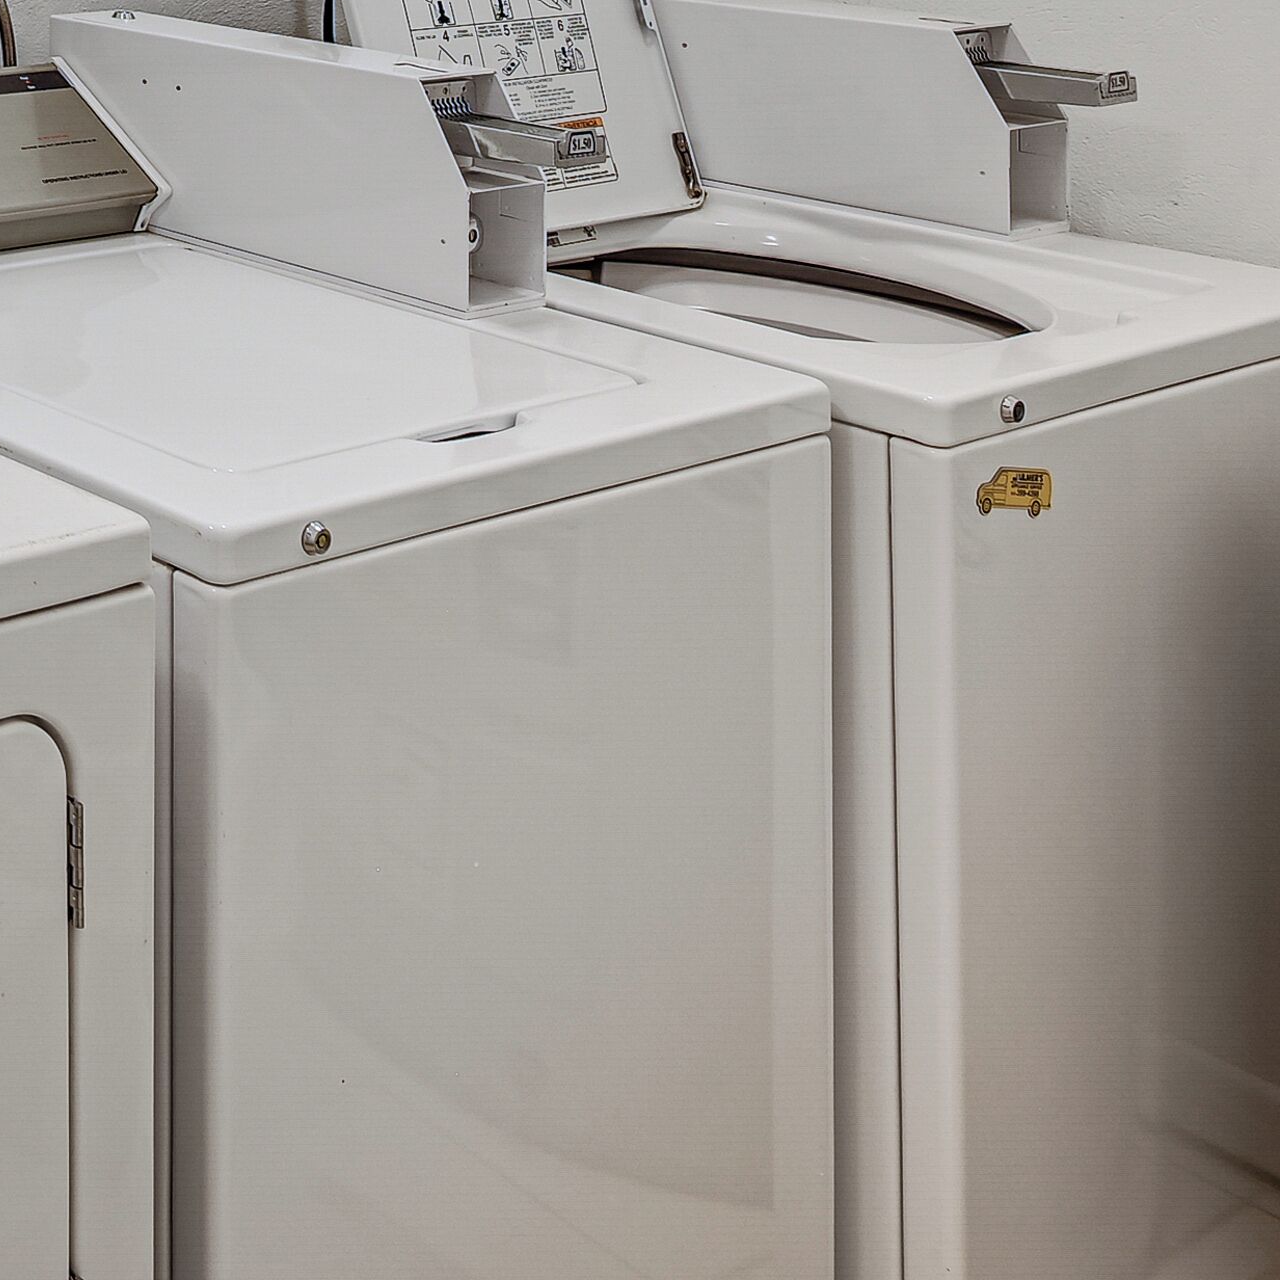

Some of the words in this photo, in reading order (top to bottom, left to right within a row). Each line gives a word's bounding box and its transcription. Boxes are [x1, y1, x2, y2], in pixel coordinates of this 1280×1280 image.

[503, 24, 510, 36] 5
[557, 19, 563, 31] 6
[442, 31, 449, 42] 4
[573, 137, 591, 151] $1.50
